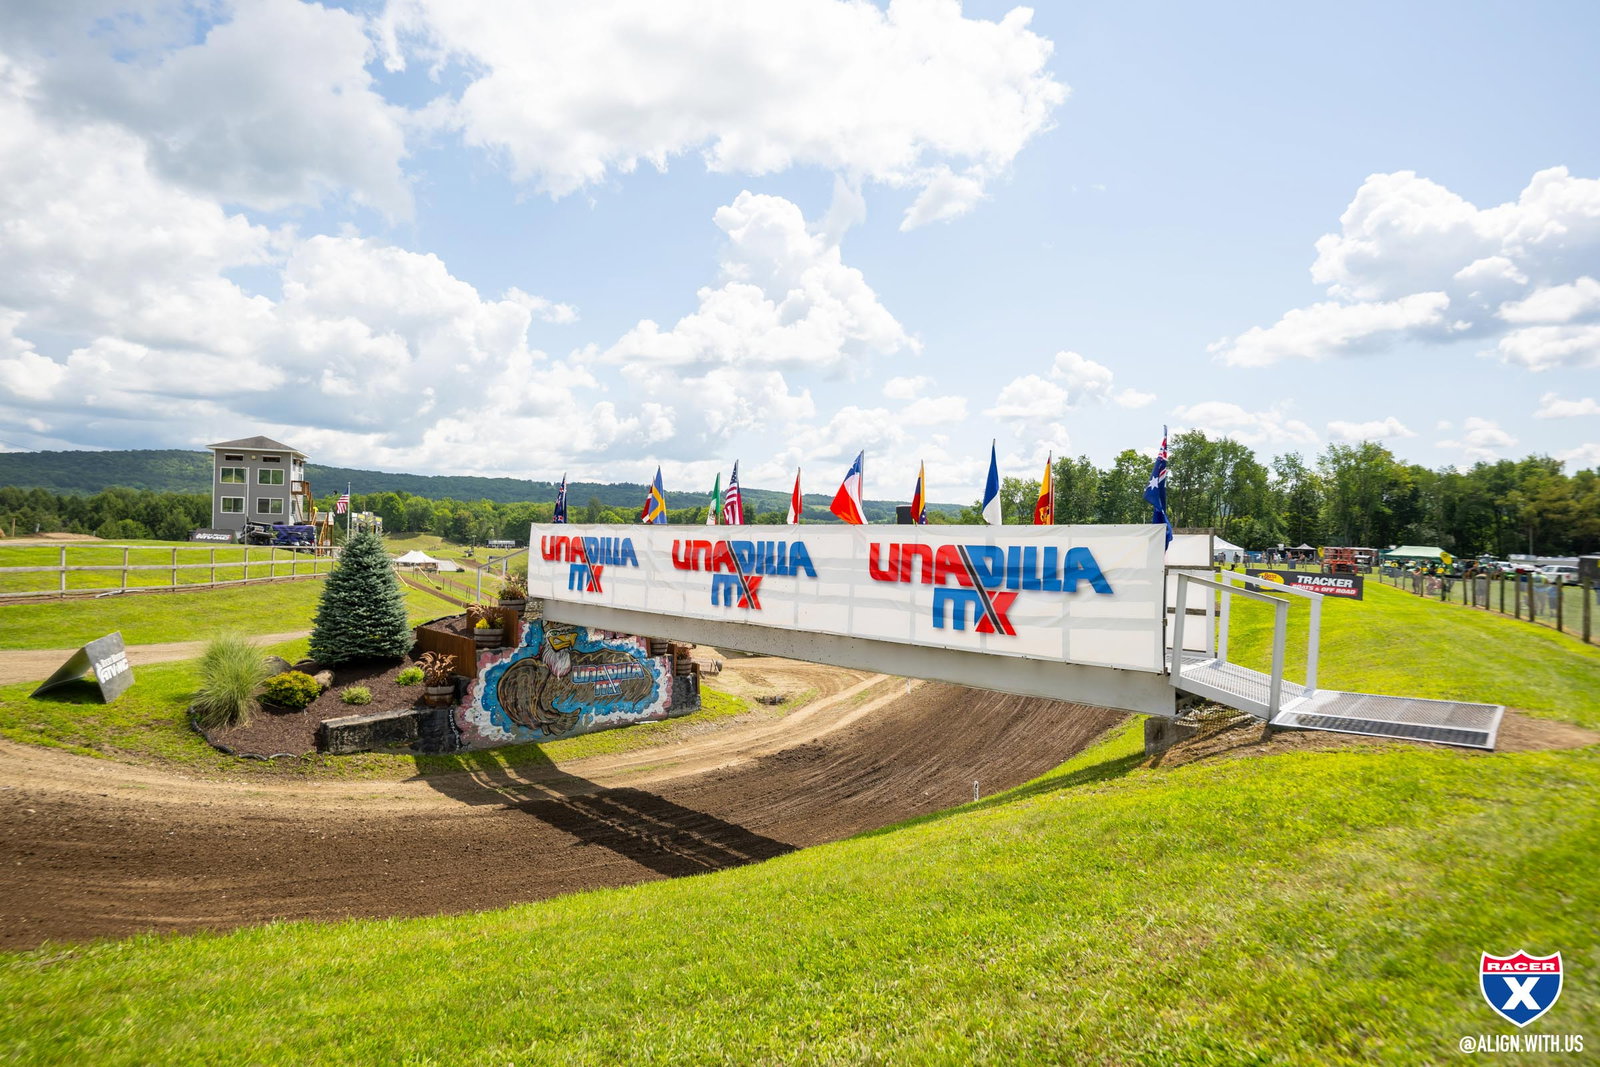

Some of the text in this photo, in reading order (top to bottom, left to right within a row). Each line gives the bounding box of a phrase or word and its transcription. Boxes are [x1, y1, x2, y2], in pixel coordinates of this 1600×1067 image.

[541, 535, 639, 567] UNADILLA
[671, 539, 818, 578] UNADILLA
[869, 542, 1114, 594] UNADILLA
[568, 563, 604, 593] MX
[711, 573, 764, 610] MX
[1296, 575, 1354, 588] TRACKER
[932, 587, 1019, 637] MX
